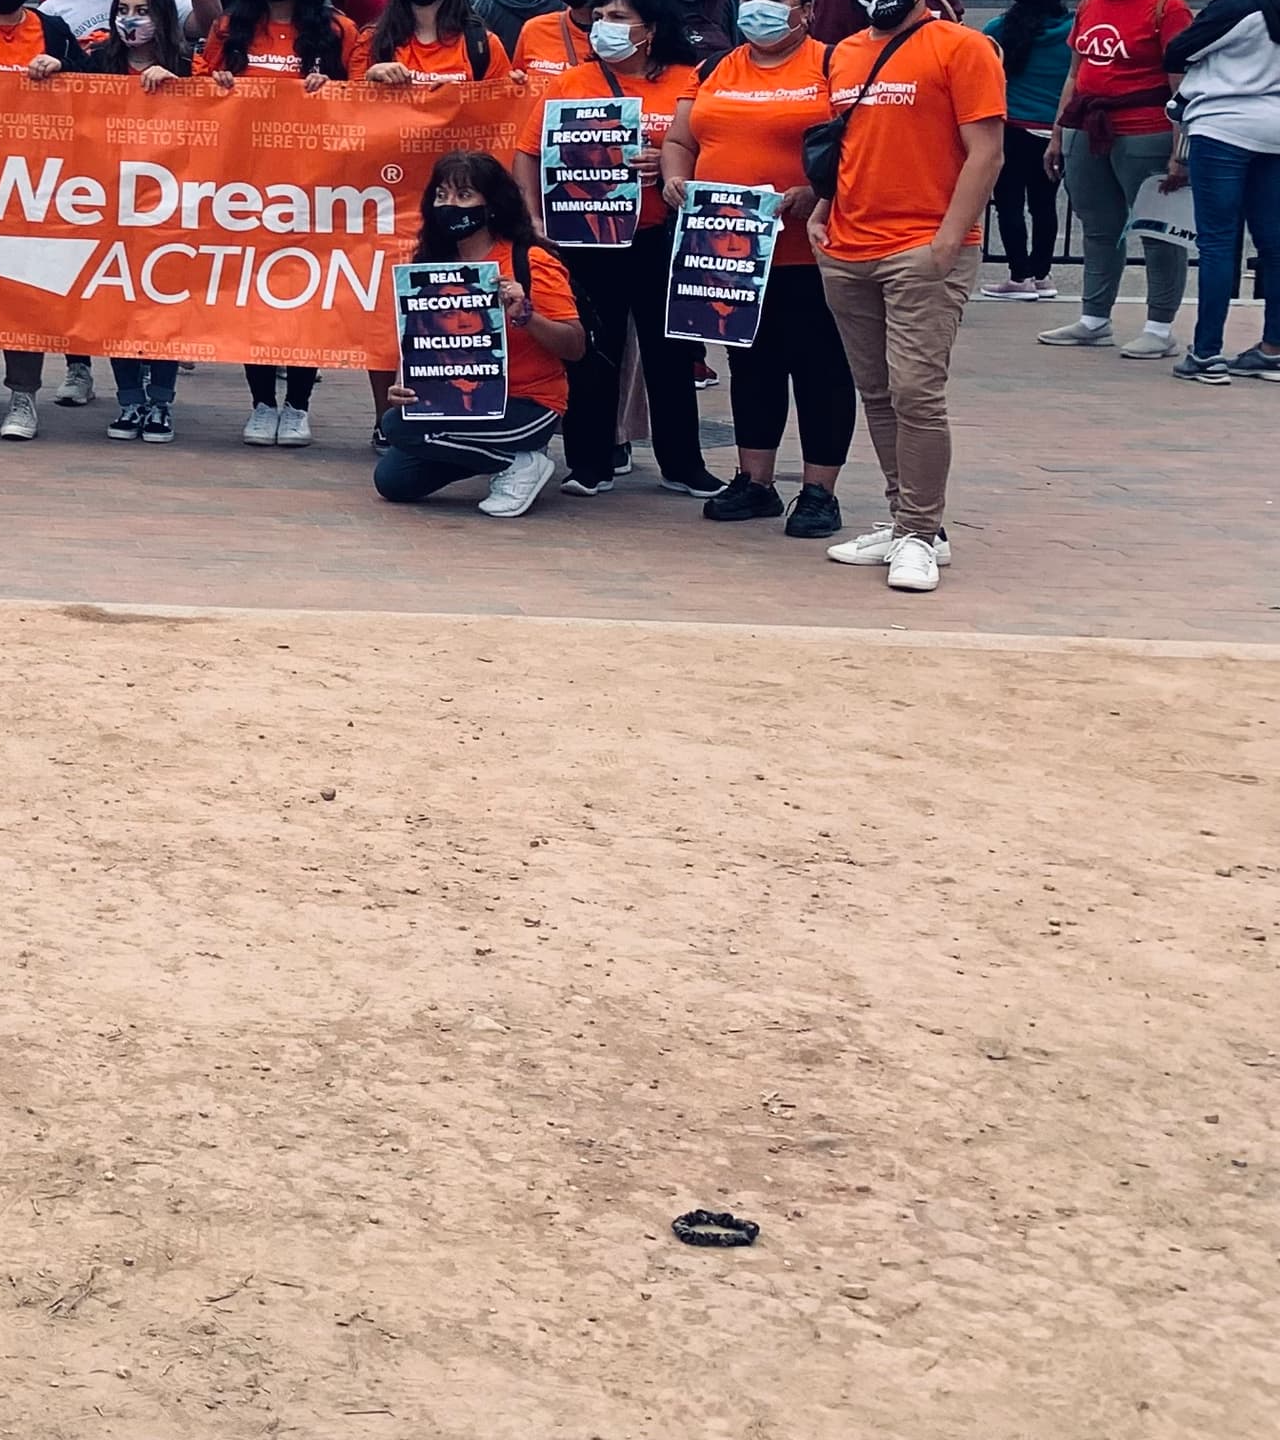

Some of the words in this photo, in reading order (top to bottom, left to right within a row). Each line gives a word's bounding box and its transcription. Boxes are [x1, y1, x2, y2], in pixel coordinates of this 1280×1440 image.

[1076, 35, 1130, 59] CASA
[64, 79, 83, 92] TO
[89, 80, 129, 95] STAY!
[233, 85, 276, 98] STAY!
[878, 81, 916, 93] Dream
[576, 109, 607, 119] REAL
[106, 118, 220, 133] UNDOCUMENTED
[252, 121, 366, 137] UNDOCUMENTED
[7, 126, 27, 139] TO
[32, 127, 74, 142] STAY!
[106, 131, 148, 145] HERE
[152, 132, 172, 145] TO
[176, 133, 219, 147] STAY!
[553, 130, 632, 143] RECOVERY
[252, 134, 293, 148] HERE
[297, 136, 317, 149] TO
[322, 137, 365, 152] STAY!
[556, 169, 629, 180] INCLUDES
[117, 160, 395, 235] Dream
[711, 193, 743, 205] REAL
[552, 202, 633, 211] IMMIGRANTS
[687, 217, 768, 232] RECOVERY
[684, 255, 755, 273] INCLUDES
[81, 241, 385, 311] ACTION
[430, 272, 464, 283] REAL
[678, 284, 756, 302] IMMIGRANTS
[407, 294, 493, 311] RECOVERY
[414, 335, 492, 349] INCLUDES
[410, 365, 499, 377] IMMIGRANTS
